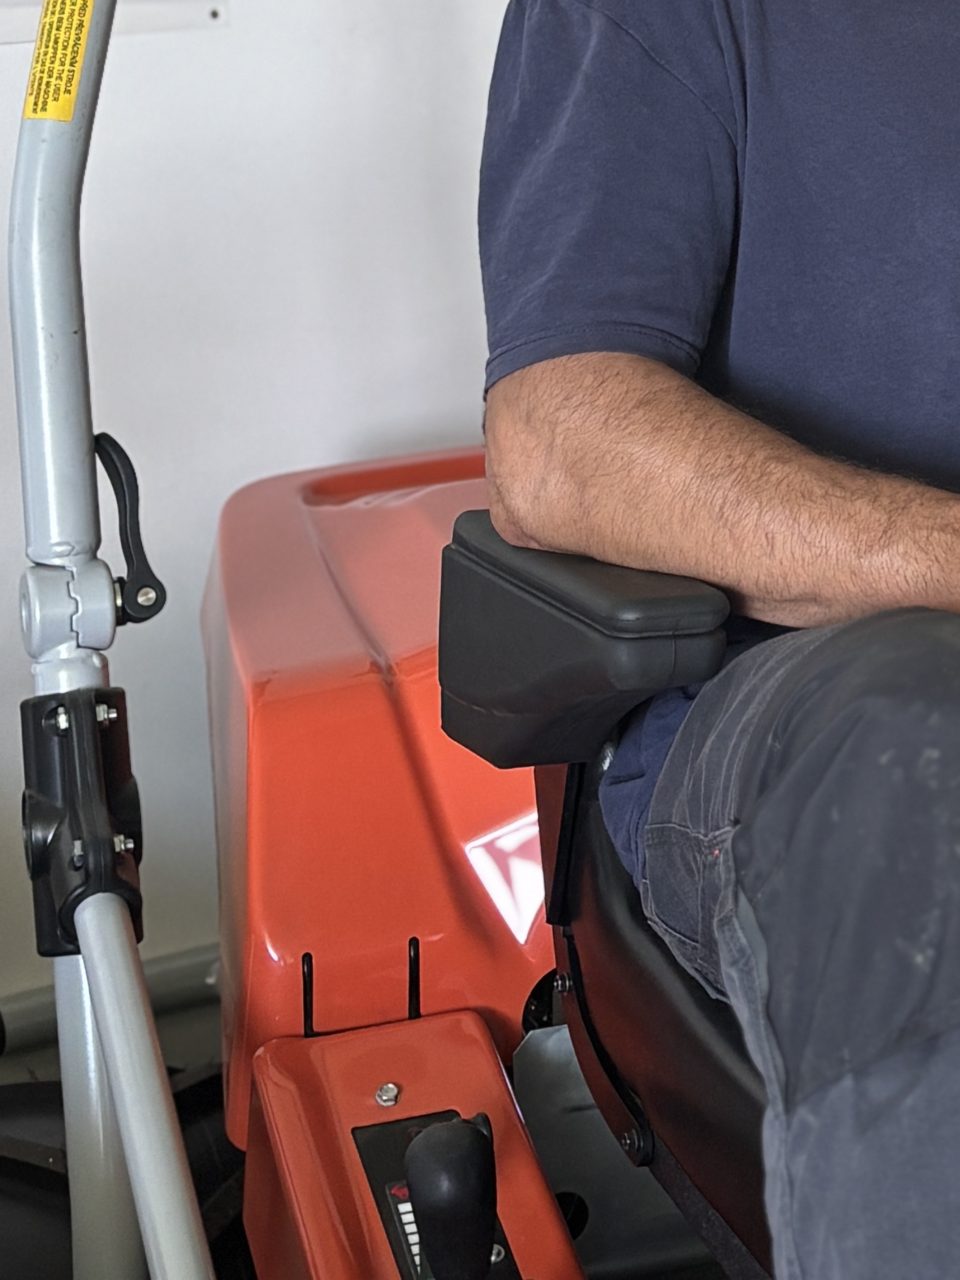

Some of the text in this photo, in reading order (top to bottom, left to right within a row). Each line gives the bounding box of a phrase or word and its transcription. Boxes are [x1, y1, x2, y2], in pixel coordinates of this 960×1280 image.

[61, 7, 75, 51] PROTECTION
[58, 52, 67, 67] FOR
[55, 68, 64, 81] THE
[51, 83, 61, 102] USER
